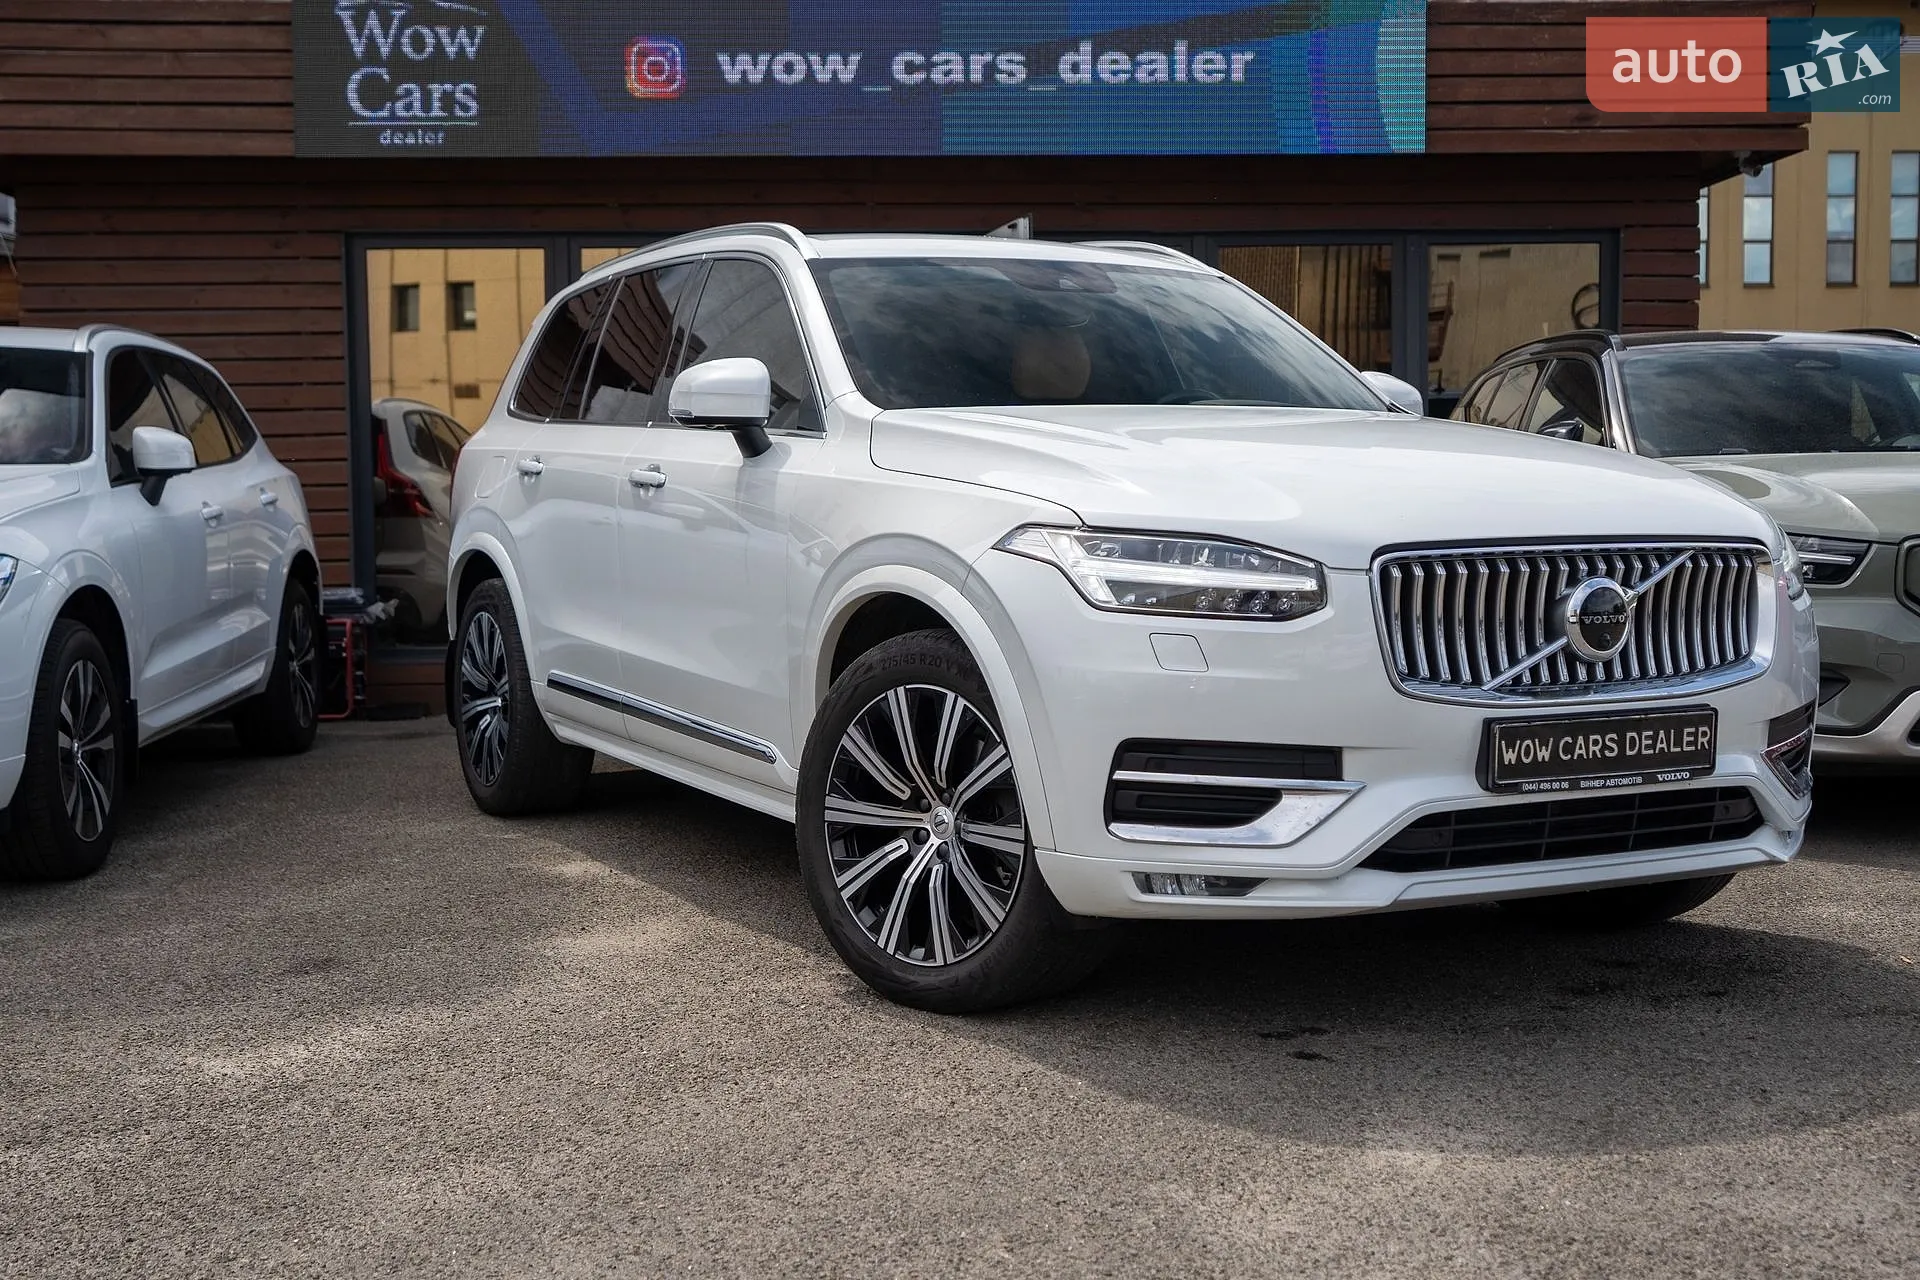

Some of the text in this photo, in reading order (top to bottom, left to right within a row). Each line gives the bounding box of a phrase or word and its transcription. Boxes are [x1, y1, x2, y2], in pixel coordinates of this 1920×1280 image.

[335, 8, 486, 60] Wow
[716, 39, 1255, 91] wow_cars_dealer
[346, 67, 479, 118] Cars
[379, 128, 445, 146] dealer
[1581, 614, 1625, 625] VOLVO
[1501, 726, 1711, 765] WOW CARS DEALER
[1656, 771, 1690, 782] VOLVO
